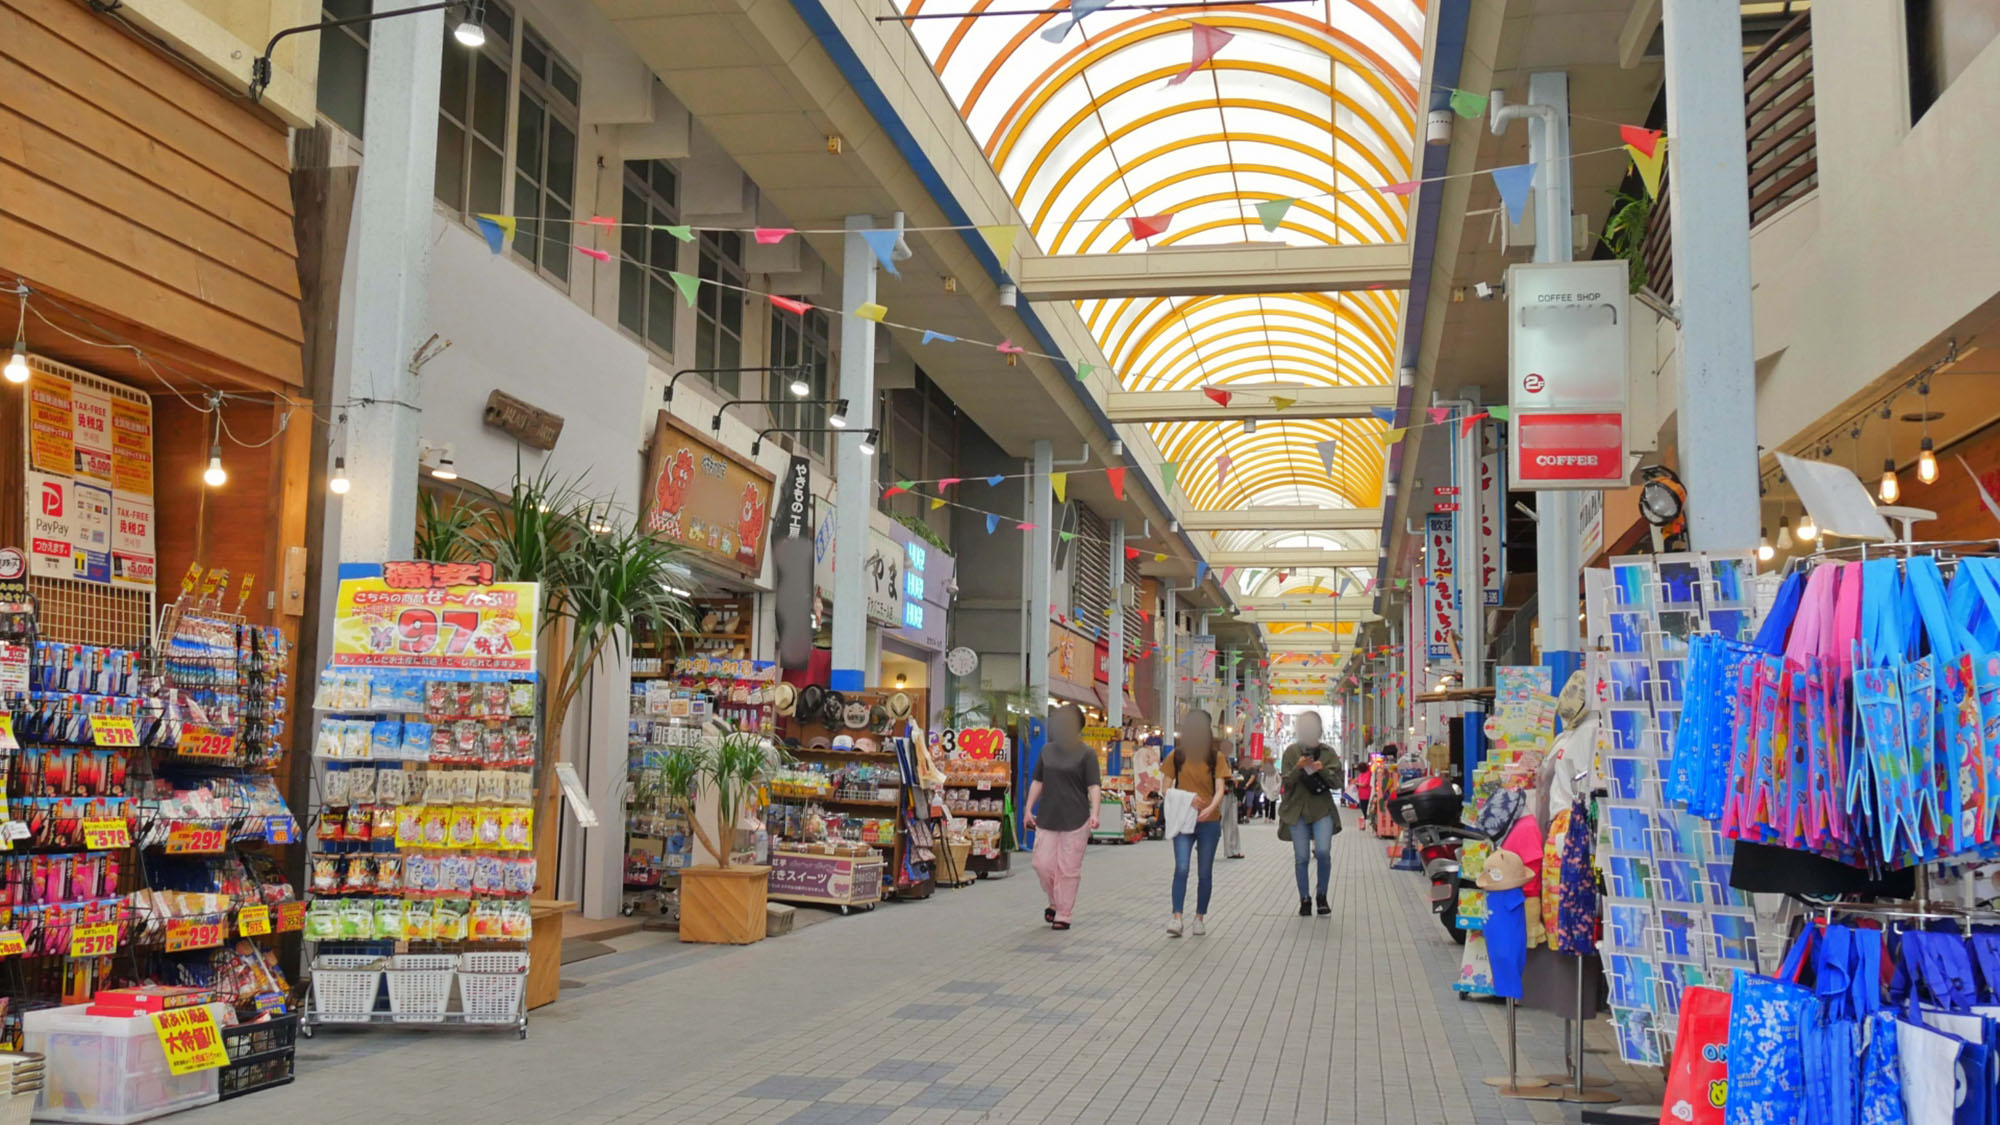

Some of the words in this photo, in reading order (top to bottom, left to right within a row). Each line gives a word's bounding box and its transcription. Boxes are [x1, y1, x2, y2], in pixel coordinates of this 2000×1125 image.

[1537, 293, 1573, 303] COFFEE
[1576, 292, 1601, 302] SHOP
[1525, 375, 1545, 390] 2F
[1535, 454, 1599, 467] COFFEE
[117, 507, 150, 522] TAX-FREE
[36, 518, 69, 537] PayPay
